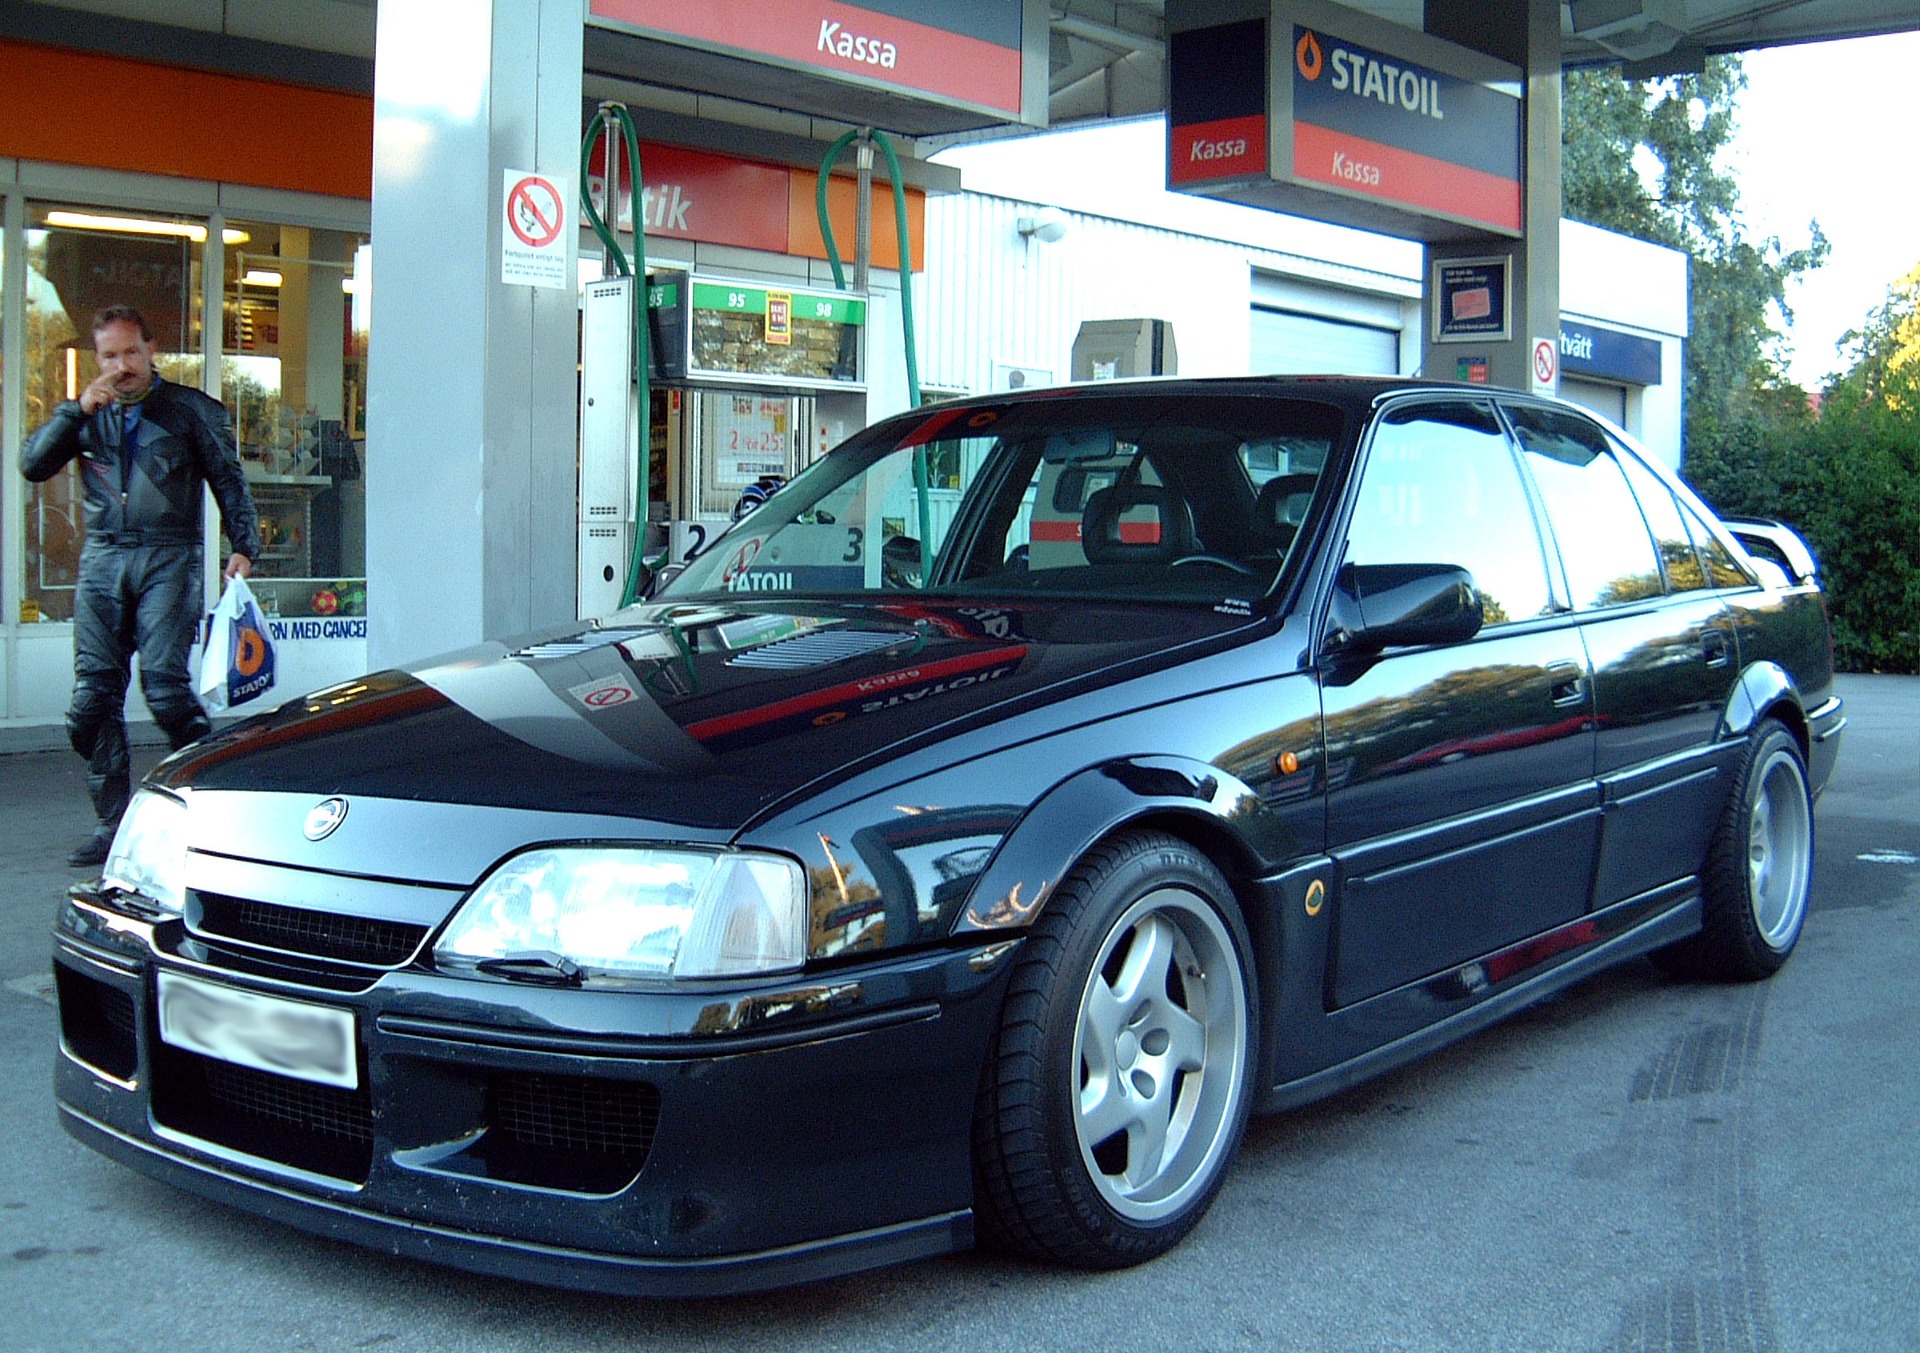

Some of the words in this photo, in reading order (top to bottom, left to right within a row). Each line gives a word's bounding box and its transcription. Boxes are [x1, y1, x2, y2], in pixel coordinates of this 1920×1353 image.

[817, 19, 897, 69] Kassa
[1331, 48, 1443, 120] STATOIL
[1190, 138, 1247, 162] Kassa
[1331, 152, 1380, 186] Kassa
[649, 293, 664, 307] 95
[728, 293, 746, 308] 95
[816, 302, 833, 318] 98
[730, 430, 739, 450] 2
[683, 525, 706, 562] 2
[843, 527, 864, 562] 3
[291, 621, 321, 640] MED
